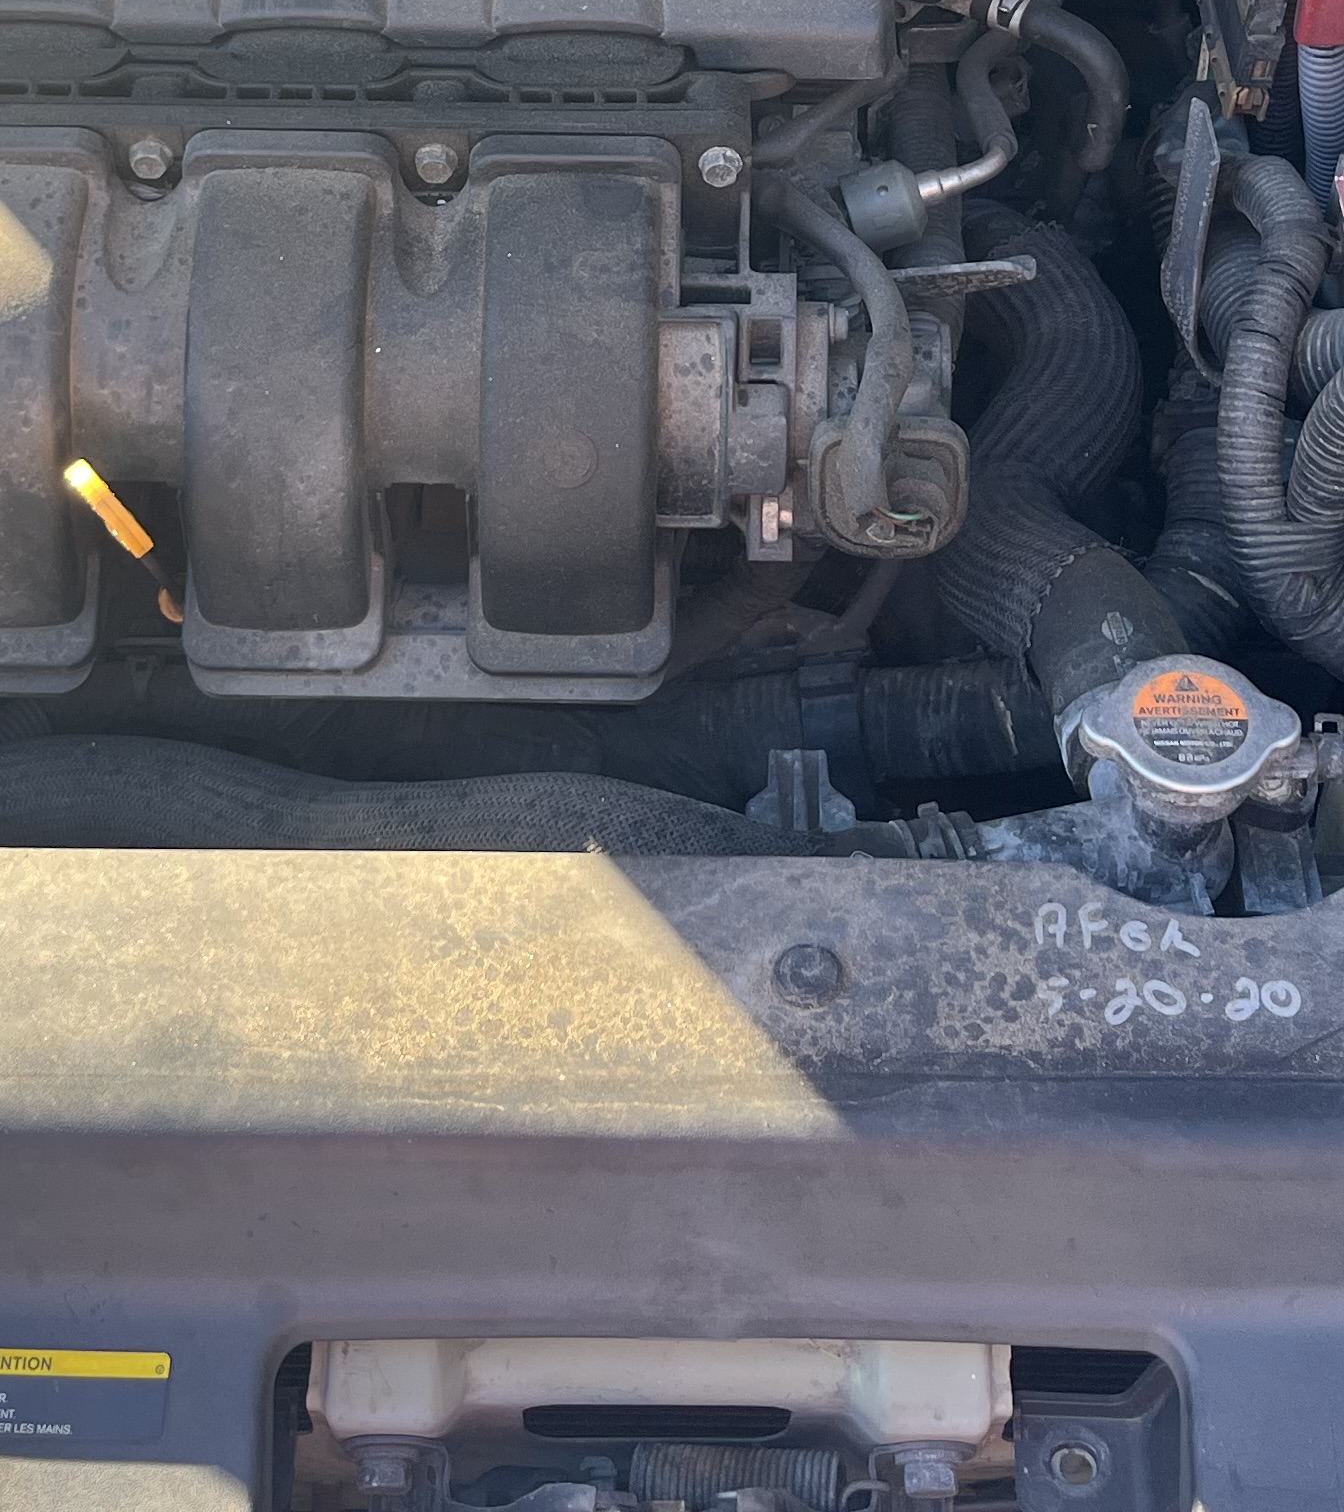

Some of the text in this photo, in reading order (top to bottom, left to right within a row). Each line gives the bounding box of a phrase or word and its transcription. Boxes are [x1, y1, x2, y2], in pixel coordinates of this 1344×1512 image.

[1154, 694, 1222, 705] WARNING
[1139, 706, 1240, 716] AVERTISSEMENT
[13, 1424, 34, 1434] LES
[36, 1424, 73, 1435] MAINS.
